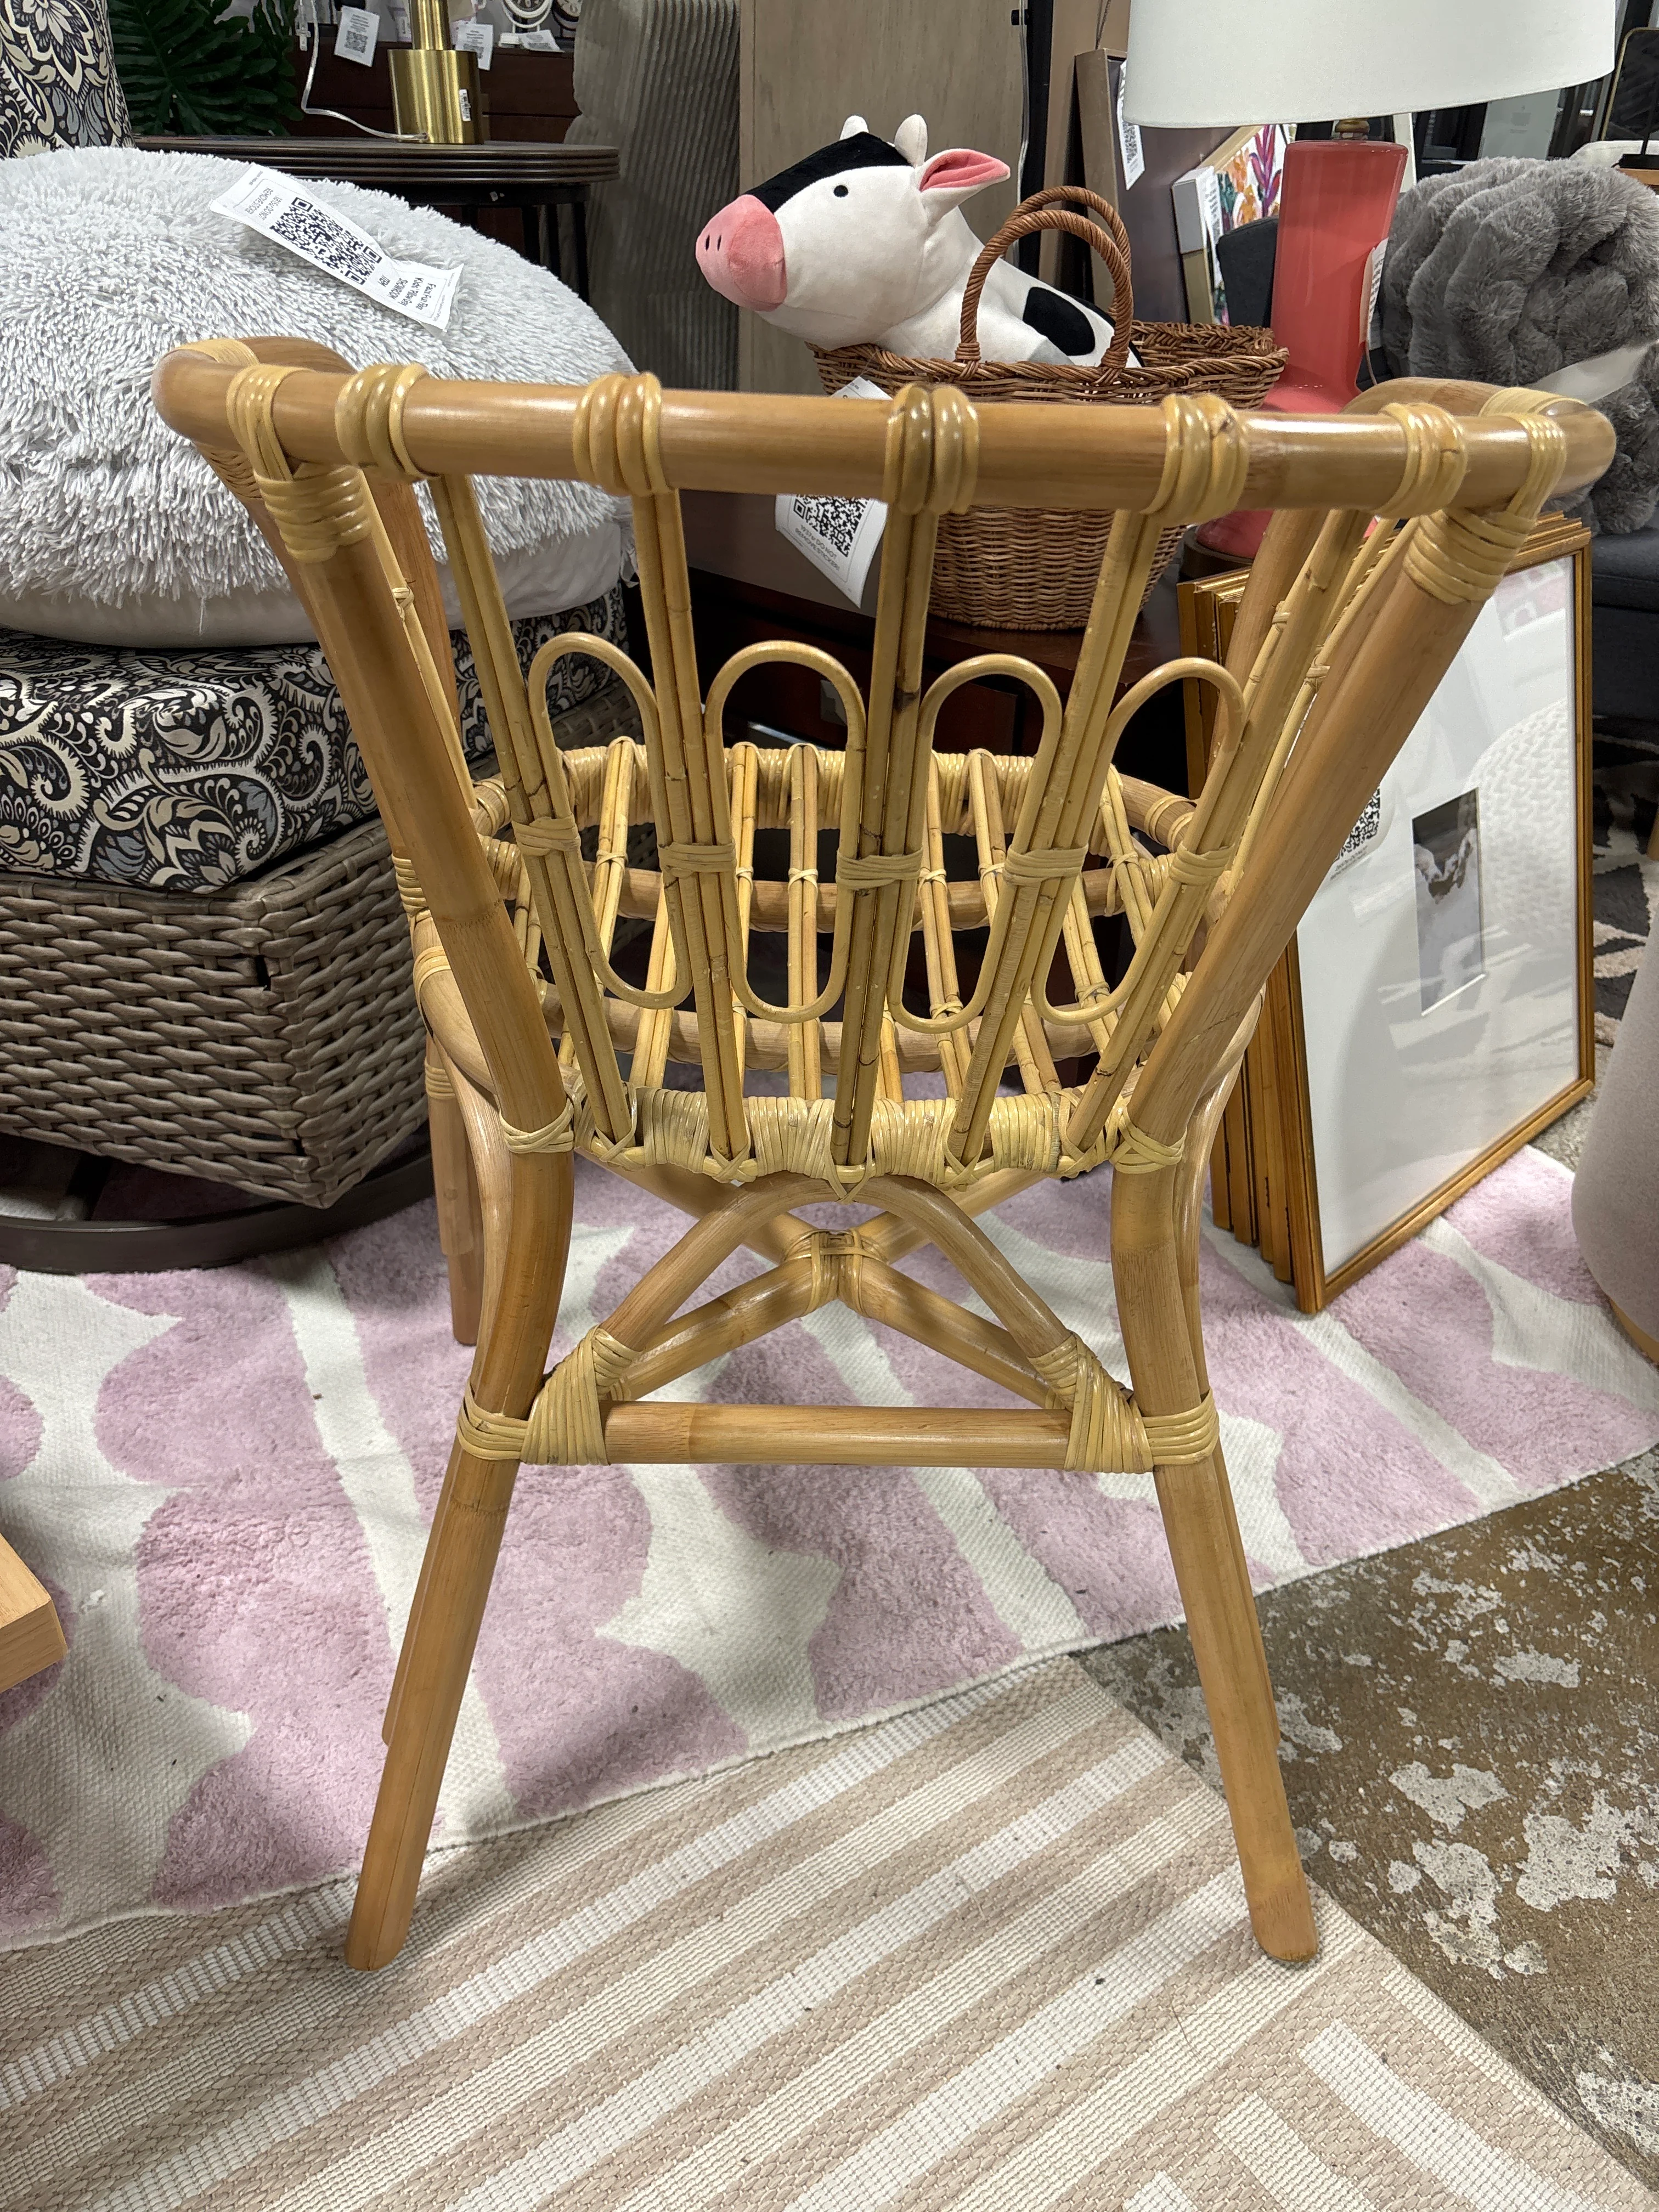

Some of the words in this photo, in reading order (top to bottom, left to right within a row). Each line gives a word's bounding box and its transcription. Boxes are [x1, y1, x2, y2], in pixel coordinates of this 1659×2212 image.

[377, 275, 391, 287] ITEM
[387, 278, 408, 300] SHOWROOM
[424, 283, 436, 295] Faux
[421, 294, 432, 303] Fur
